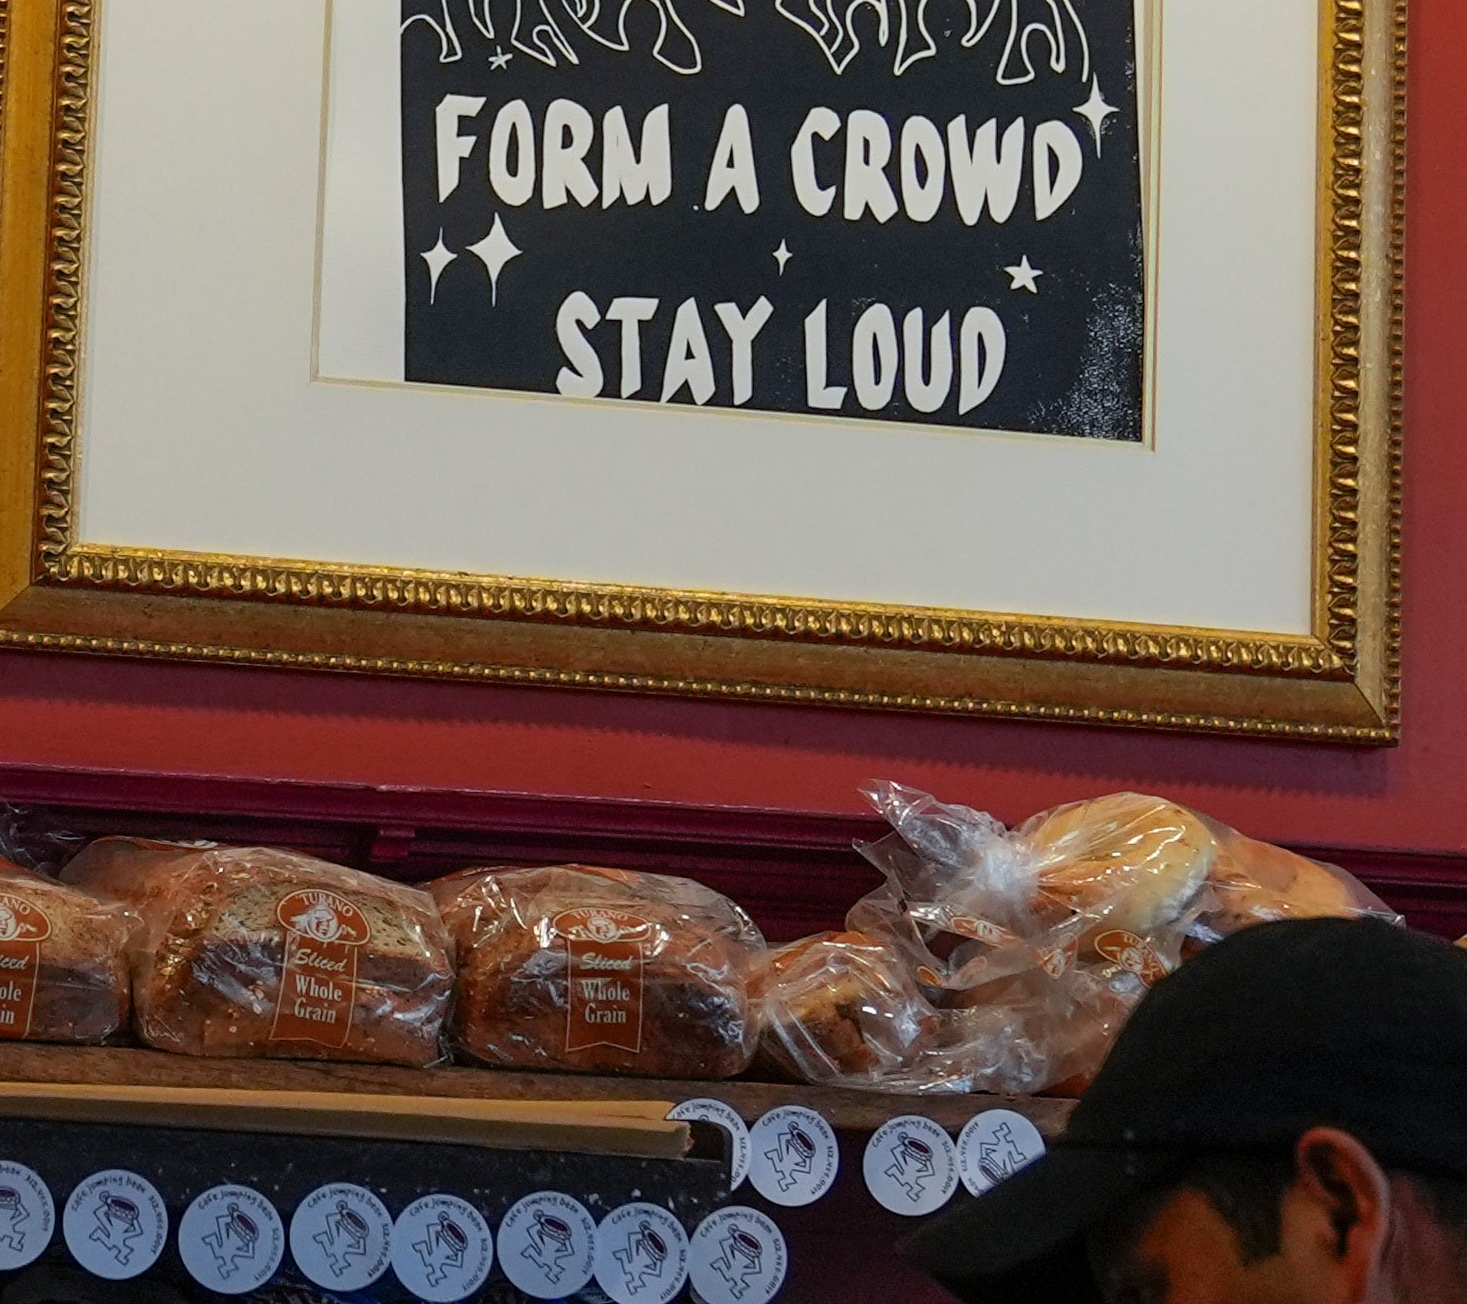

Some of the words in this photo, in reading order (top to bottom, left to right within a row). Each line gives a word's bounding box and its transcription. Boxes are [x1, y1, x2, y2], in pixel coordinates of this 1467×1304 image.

[435, 93, 672, 209] FORM
[705, 103, 761, 214] A
[790, 106, 1083, 226] CROWD
[555, 290, 774, 406] STAY
[805, 297, 1006, 415] LOUD
[299, 892, 355, 917] TURANO
[294, 948, 348, 972] Sliced
[295, 974, 343, 1002] Whole
[580, 978, 630, 1001] Whole
[294, 997, 337, 1025] Grain
[584, 1002, 627, 1024] Grain
